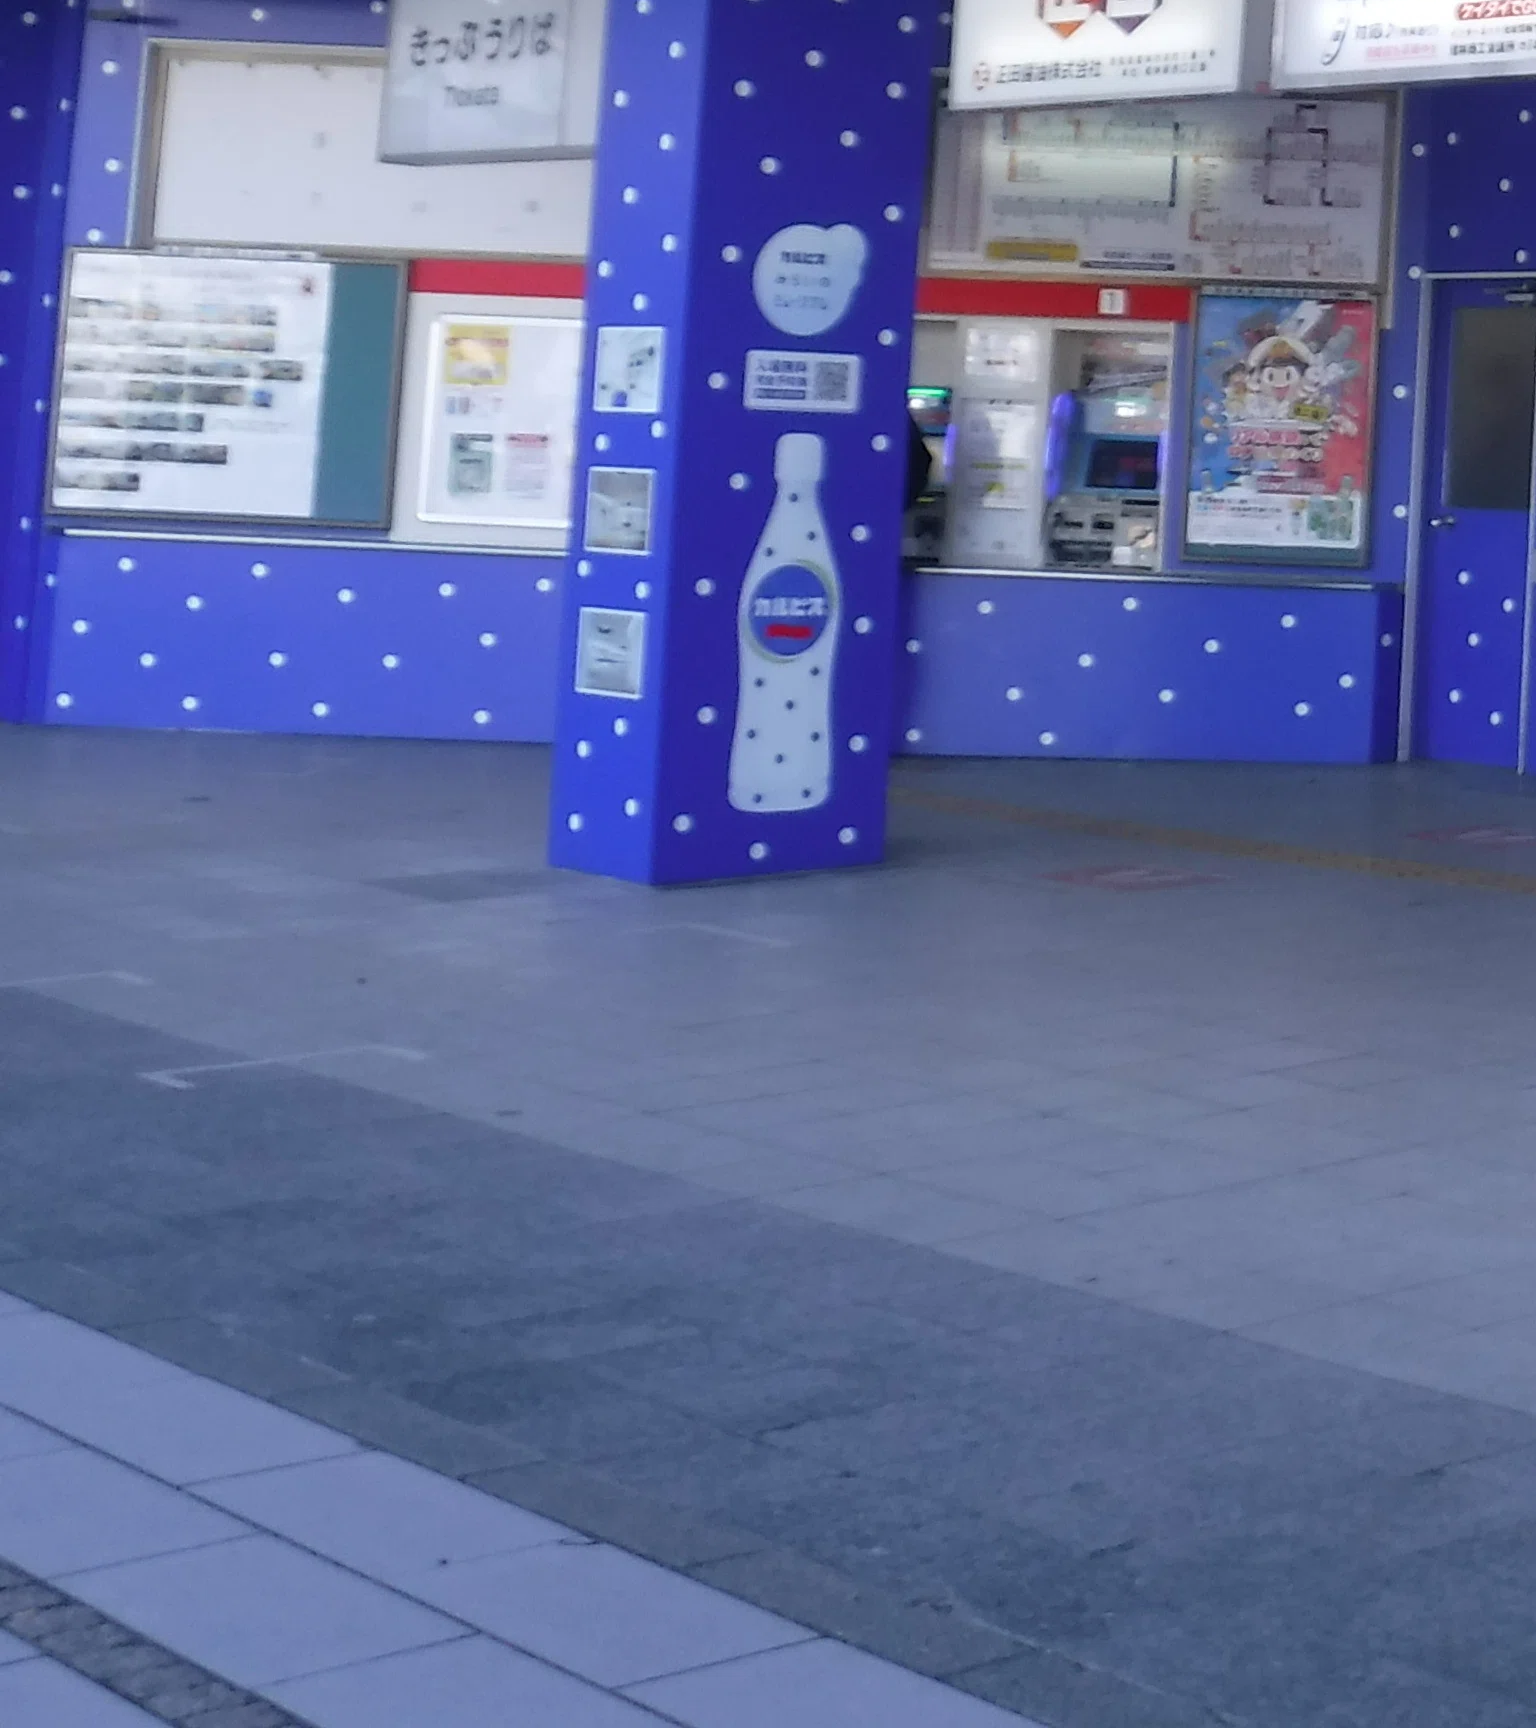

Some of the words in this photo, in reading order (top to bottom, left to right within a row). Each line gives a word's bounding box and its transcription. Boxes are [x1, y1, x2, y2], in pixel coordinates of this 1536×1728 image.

[410, 12, 555, 67] きっぷうりば
